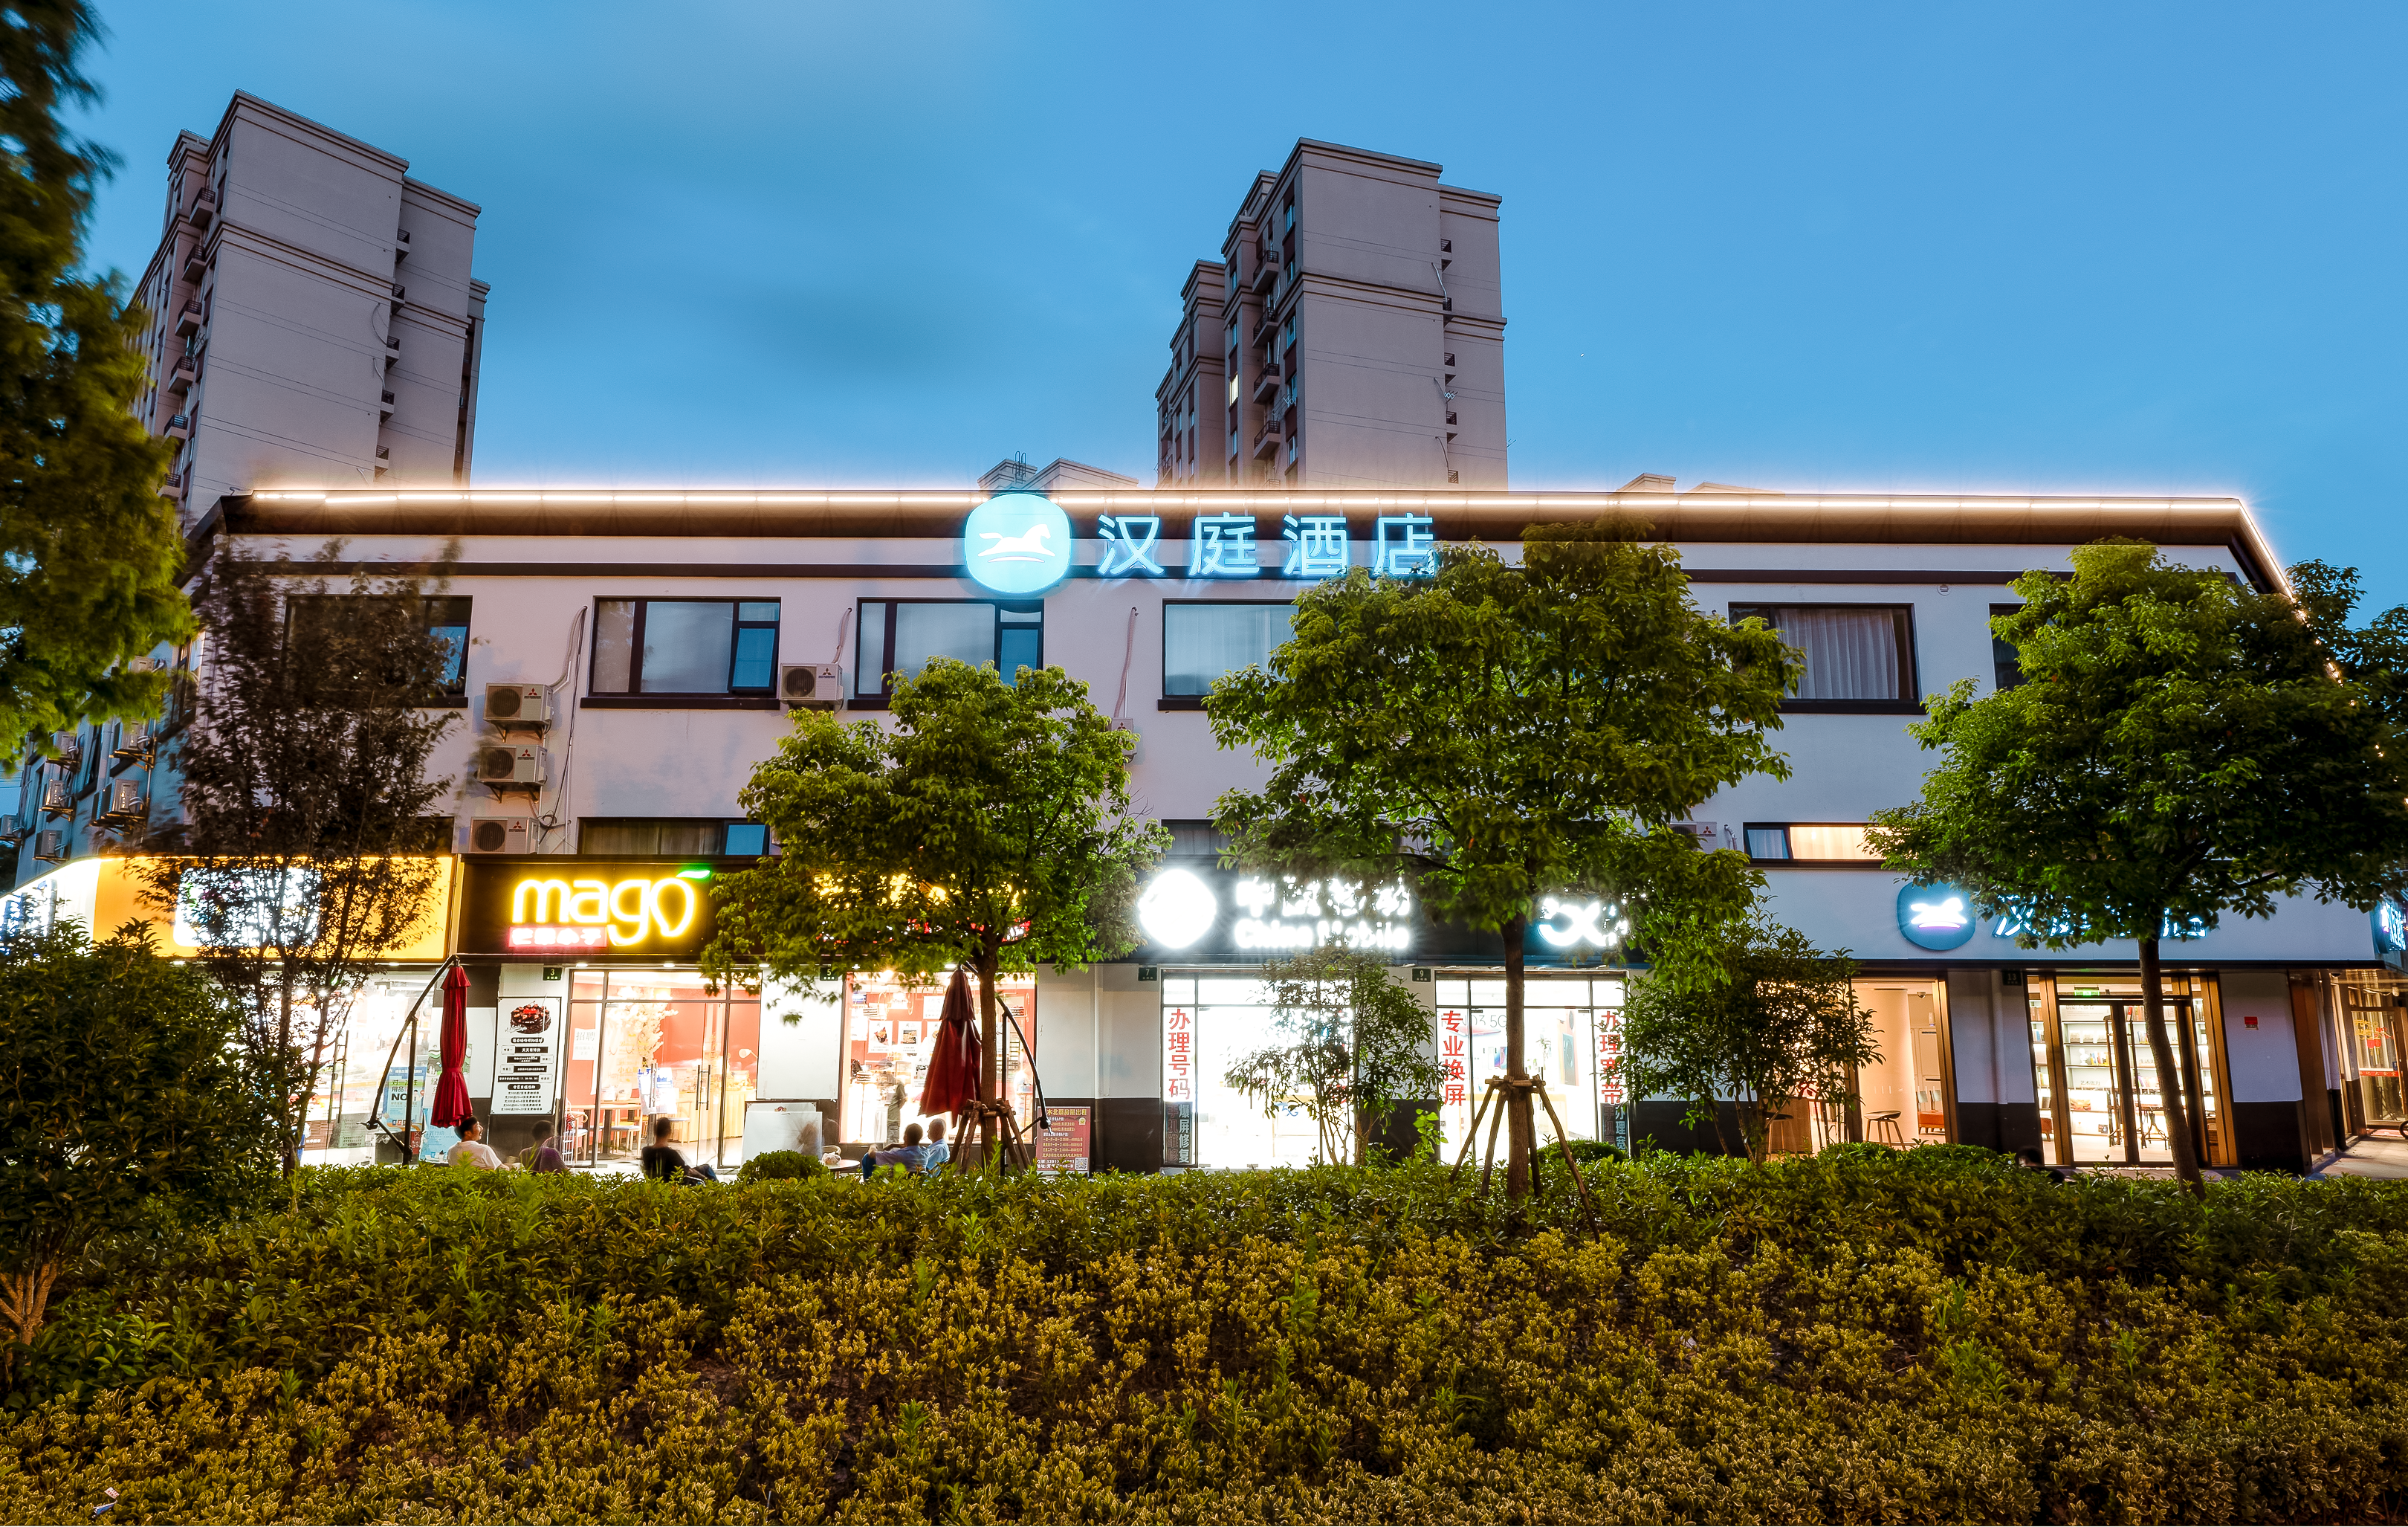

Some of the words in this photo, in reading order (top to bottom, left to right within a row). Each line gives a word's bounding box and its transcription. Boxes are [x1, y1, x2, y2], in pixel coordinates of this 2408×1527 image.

[1098, 511, 1436, 575] 汉庭酒店
[511, 878, 696, 946] mago
[550, 968, 555, 976] 3
[1420, 969, 1424, 978] 9
[1168, 1008, 1191, 1100] 办理号码
[1441, 1010, 1466, 1106] 专业换屏
[1168, 1104, 1179, 1163] 手机维修
[1179, 1104, 1190, 1163] 爆屏修复
